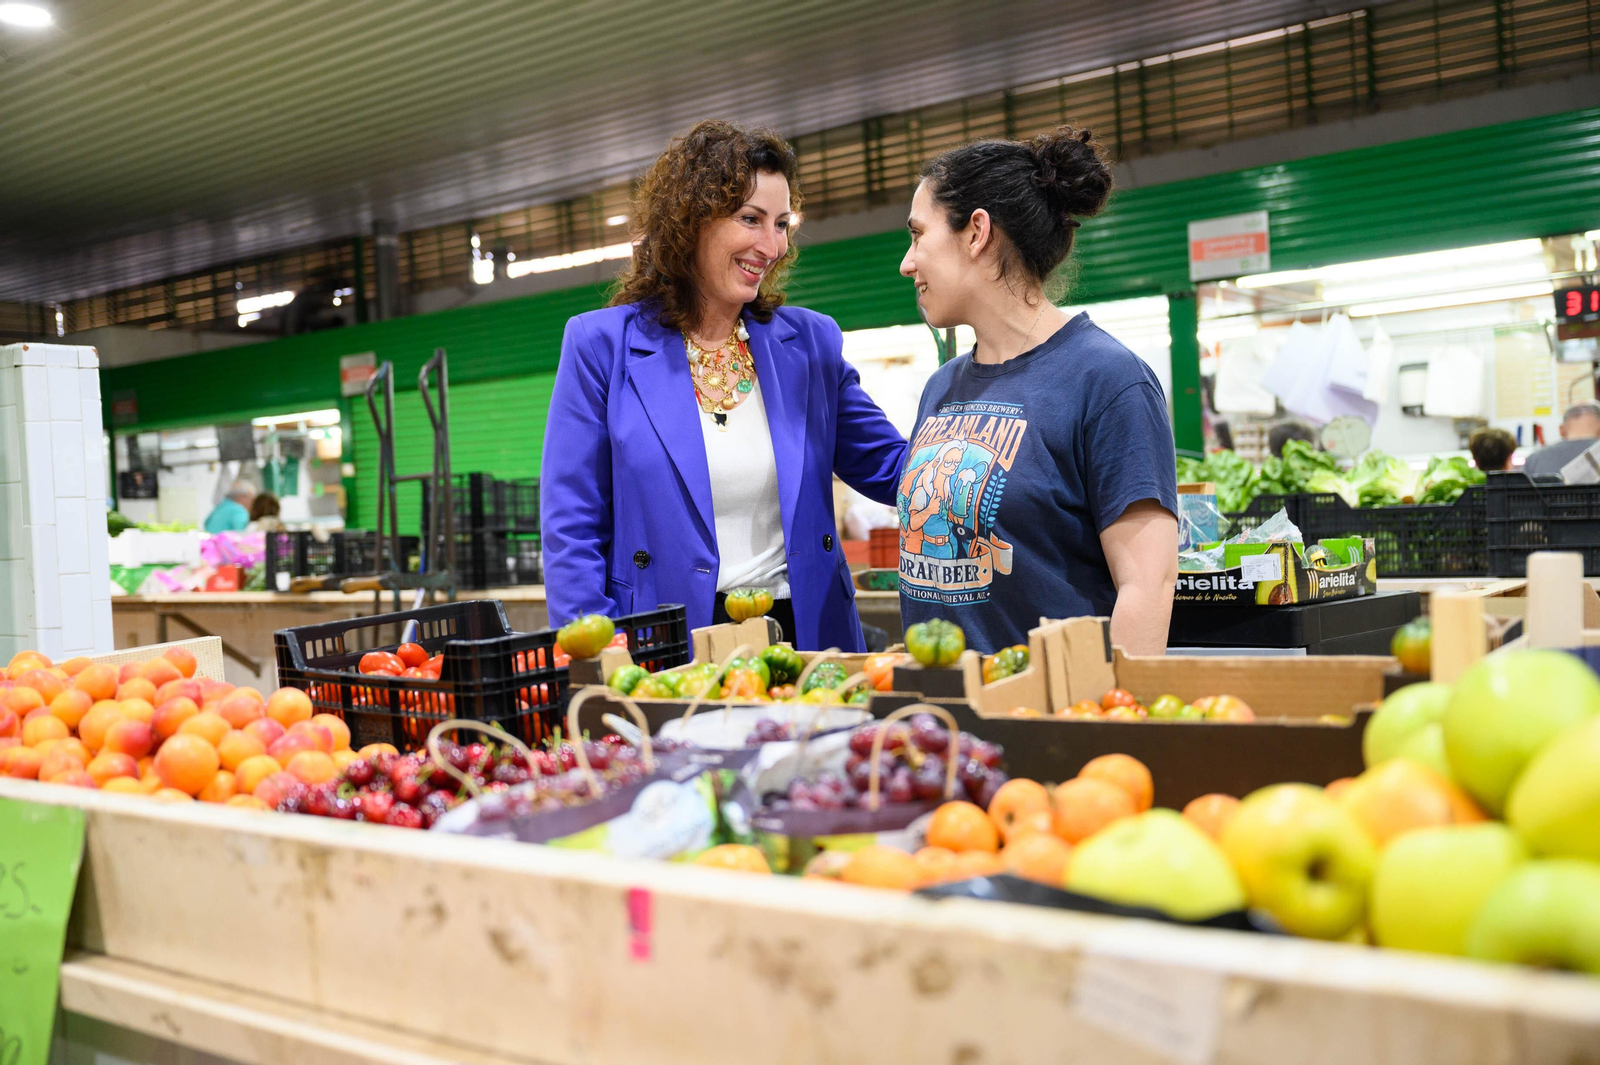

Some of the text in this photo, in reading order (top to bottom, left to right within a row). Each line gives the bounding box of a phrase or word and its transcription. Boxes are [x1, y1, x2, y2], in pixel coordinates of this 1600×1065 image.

[987, 404, 1021, 415] BREWERY
[913, 415, 1028, 472] DREAMLAND
[900, 556, 980, 584] DRAFT BEER
[1173, 575, 1255, 591] rielita
[1319, 573, 1356, 589] arielita
